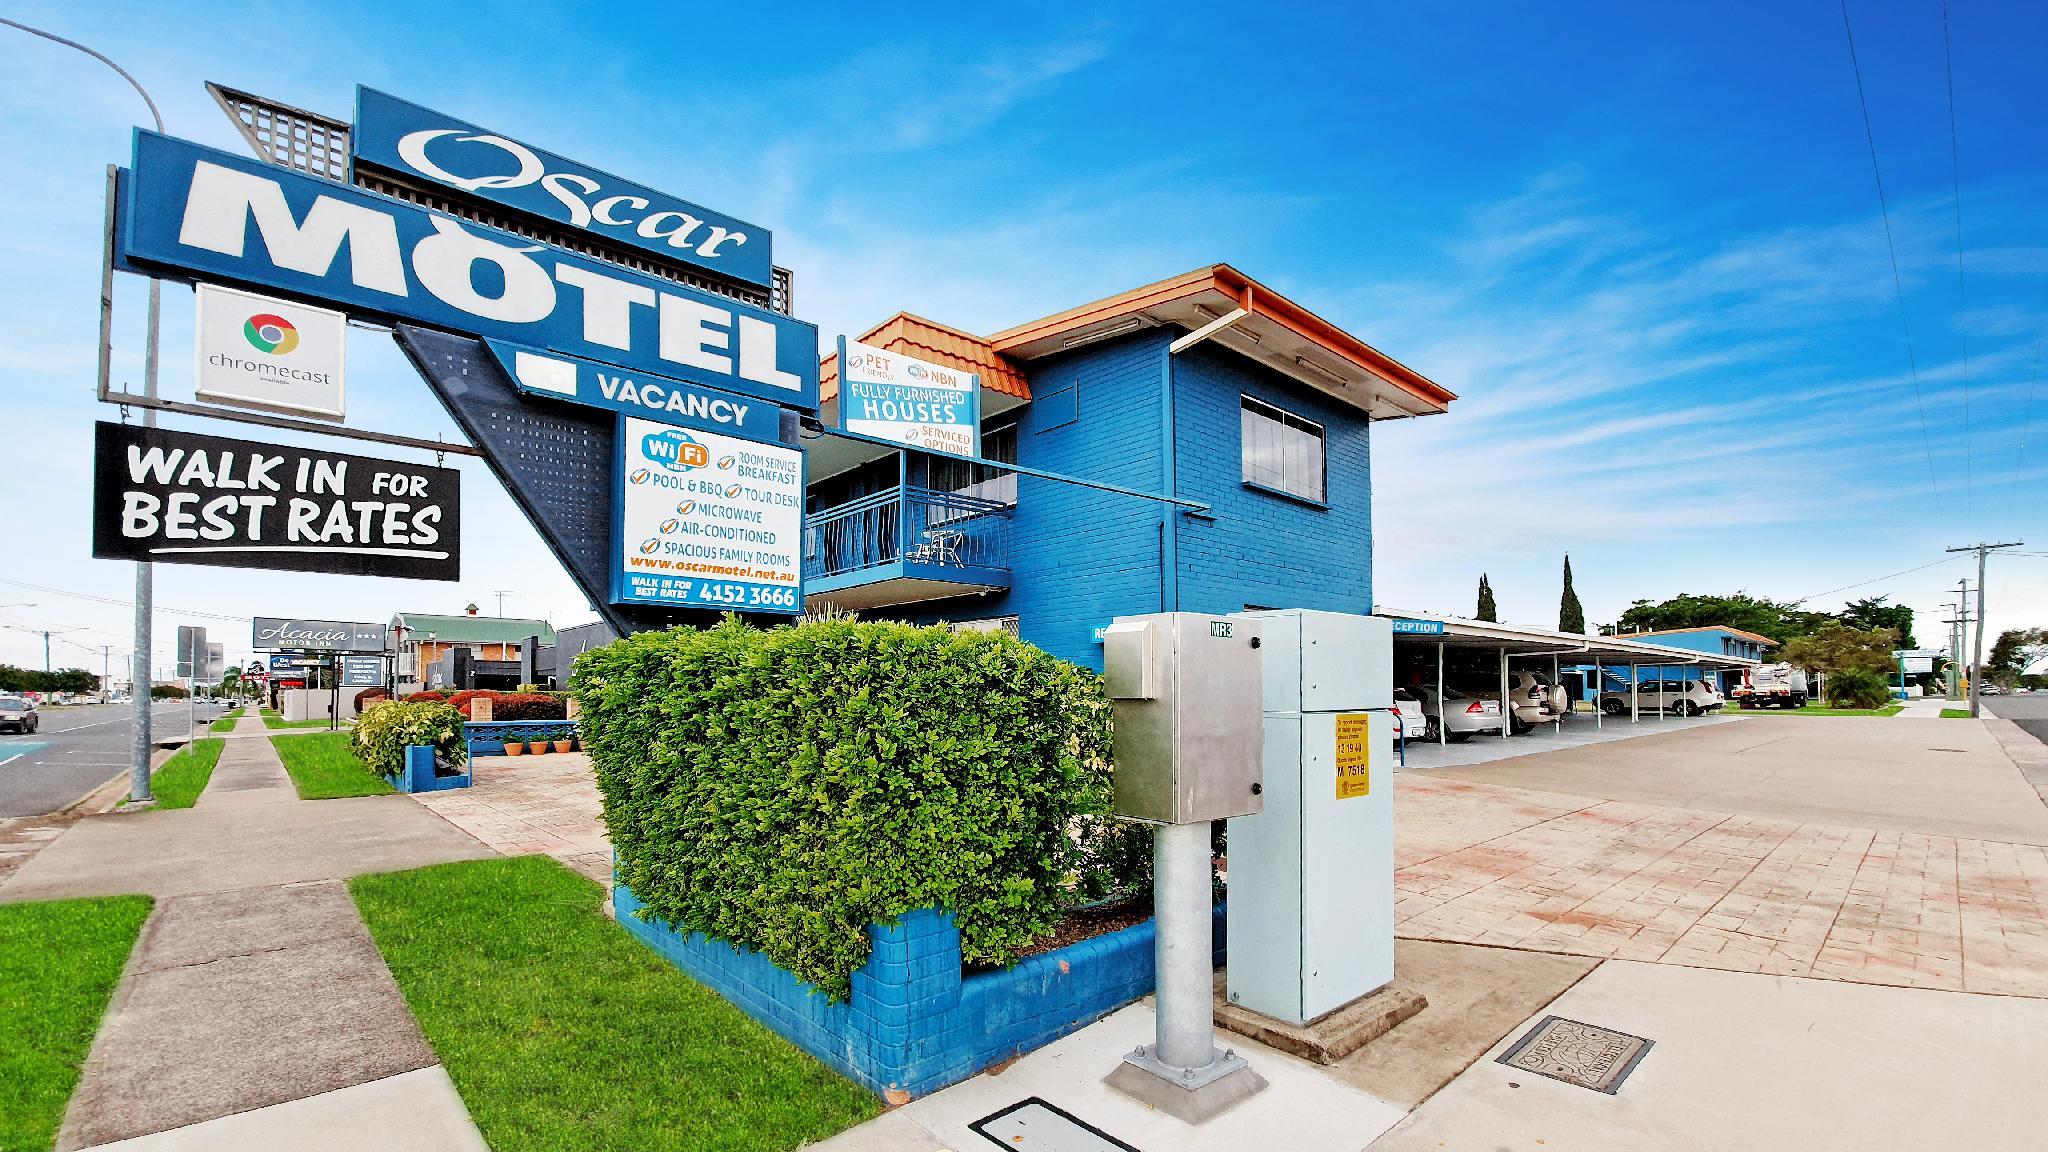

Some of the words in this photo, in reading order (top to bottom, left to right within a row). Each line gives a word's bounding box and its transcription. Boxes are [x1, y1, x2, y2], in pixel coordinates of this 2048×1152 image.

[398, 130, 748, 258] Oscar
[178, 160, 802, 393] MOTEL
[209, 353, 331, 385] chromecast
[866, 354, 891, 371] PET
[259, 376, 290, 385] available
[862, 367, 895, 381] FRIENDLY
[931, 371, 957, 387] NBN
[597, 373, 749, 427] VACANCY
[851, 383, 891, 399] FULLY
[894, 388, 965, 405] FURNISHED
[863, 399, 957, 424] HOUSES
[666, 431, 687, 440] FREE
[922, 426, 970, 445] SERVICED
[924, 438, 969, 456] OPTIONS
[127, 444, 285, 492] WALK
[295, 457, 348, 496] IN
[371, 472, 429, 498] FOR
[666, 463, 686, 472] NBN
[738, 452, 764, 466] ROOM
[765, 456, 797, 473] SERVICE
[738, 465, 797, 485] BREAKFAST
[653, 473, 685, 491] POOL
[687, 480, 697, 492] &
[700, 481, 723, 499] BBQ
[745, 487, 773, 503] TOUR
[774, 493, 800, 509] DESK
[121, 491, 277, 541] BEST
[287, 497, 442, 545] RATES
[698, 503, 763, 524] MICROWAVE
[681, 521, 776, 545] AIR-CONDITIONED
[664, 541, 717, 559] SPACIOUS
[719, 547, 753, 564] FAMILY
[756, 552, 790, 567] ROOMS
[630, 556, 795, 582] www.oscarmotel.net.au
[631, 577, 659, 588] WALK
[661, 579, 672, 589] IN
[674, 580, 693, 590] FOR
[635, 587, 657, 597] BEST
[659, 589, 688, 599] RATES
[699, 583, 745, 603] 4152
[750, 587, 795, 607] 3666
[257, 621, 350, 641] Acacia
[1211, 622, 1233, 638] MR3
[1347, 744, 1353, 753] 19
[1338, 766, 1344, 777] M
[1348, 764, 1364, 776] 7518
